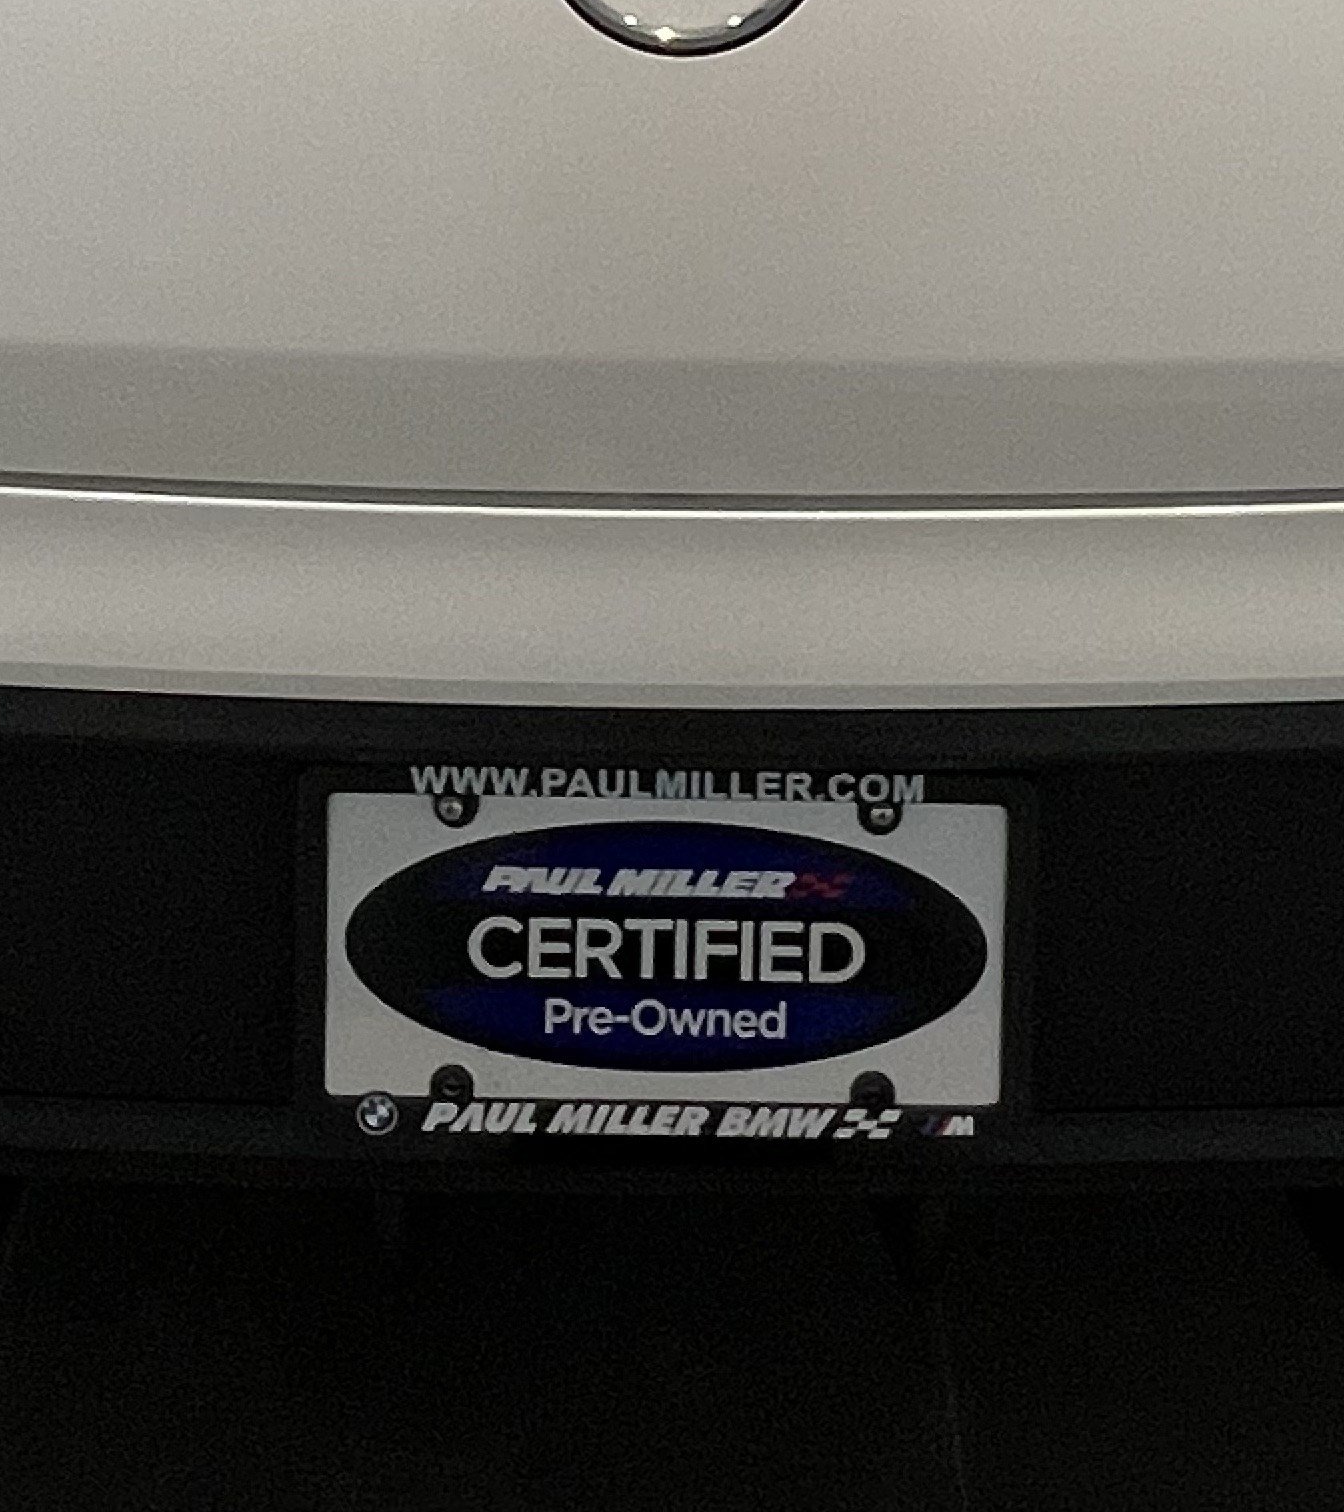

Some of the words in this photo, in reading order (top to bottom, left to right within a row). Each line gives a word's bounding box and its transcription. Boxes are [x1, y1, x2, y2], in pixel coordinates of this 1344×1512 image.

[410, 765, 925, 804] WWW.PAULMILLER.COM
[481, 865, 602, 895] PAUL
[606, 868, 796, 899] MILLER
[467, 915, 867, 985] CERTIFIED
[543, 997, 788, 1040] Pre-Owned
[421, 1101, 536, 1134] PAUL
[546, 1103, 708, 1137] MILLER
[716, 1106, 838, 1139] BMW
